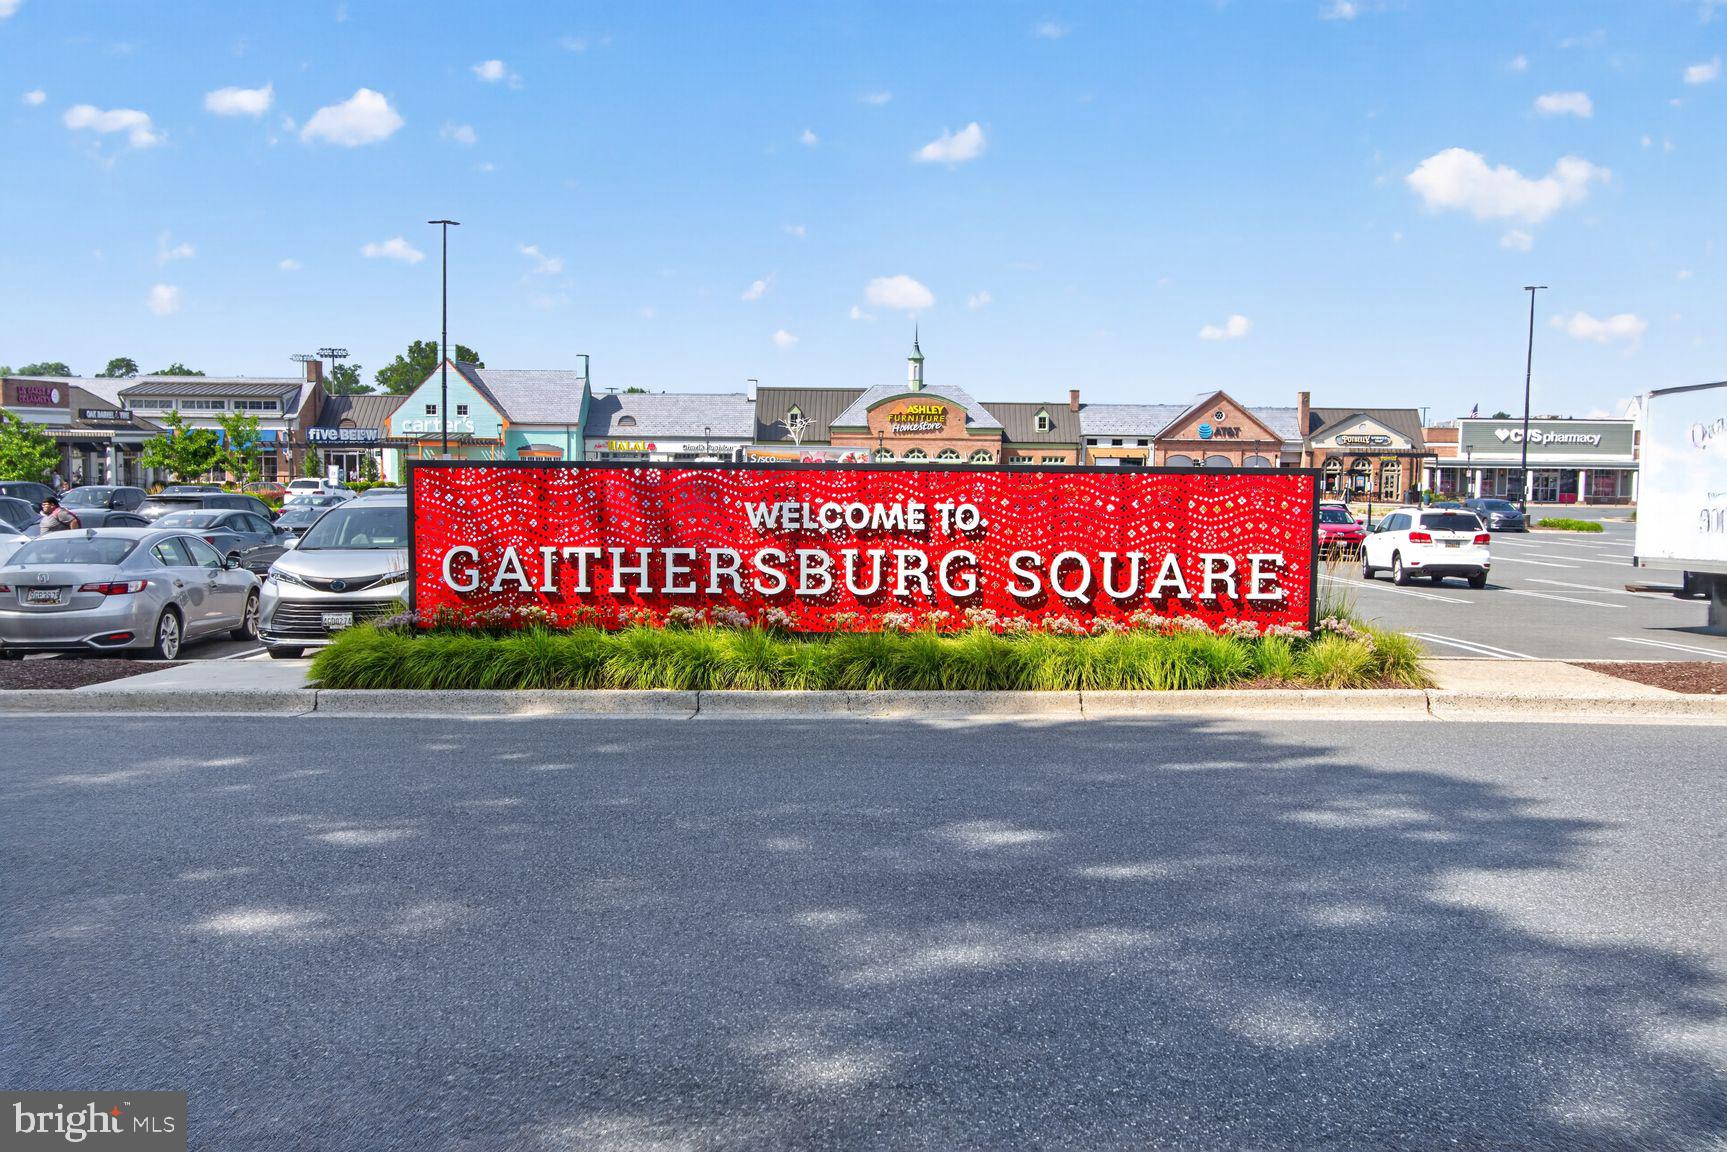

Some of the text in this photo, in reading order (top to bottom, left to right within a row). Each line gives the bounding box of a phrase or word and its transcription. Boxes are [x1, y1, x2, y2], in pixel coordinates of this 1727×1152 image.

[906, 404, 945, 415] ASHLEY
[402, 417, 475, 432] carter's
[888, 414, 945, 422] FURNITURE
[309, 428, 338, 440] five
[1214, 426, 1241, 439] AT&T
[1542, 431, 1601, 445] pharmacy
[745, 501, 980, 532] WELCOME TO
[441, 545, 1285, 604] GAITHERSBURG SQUARE
